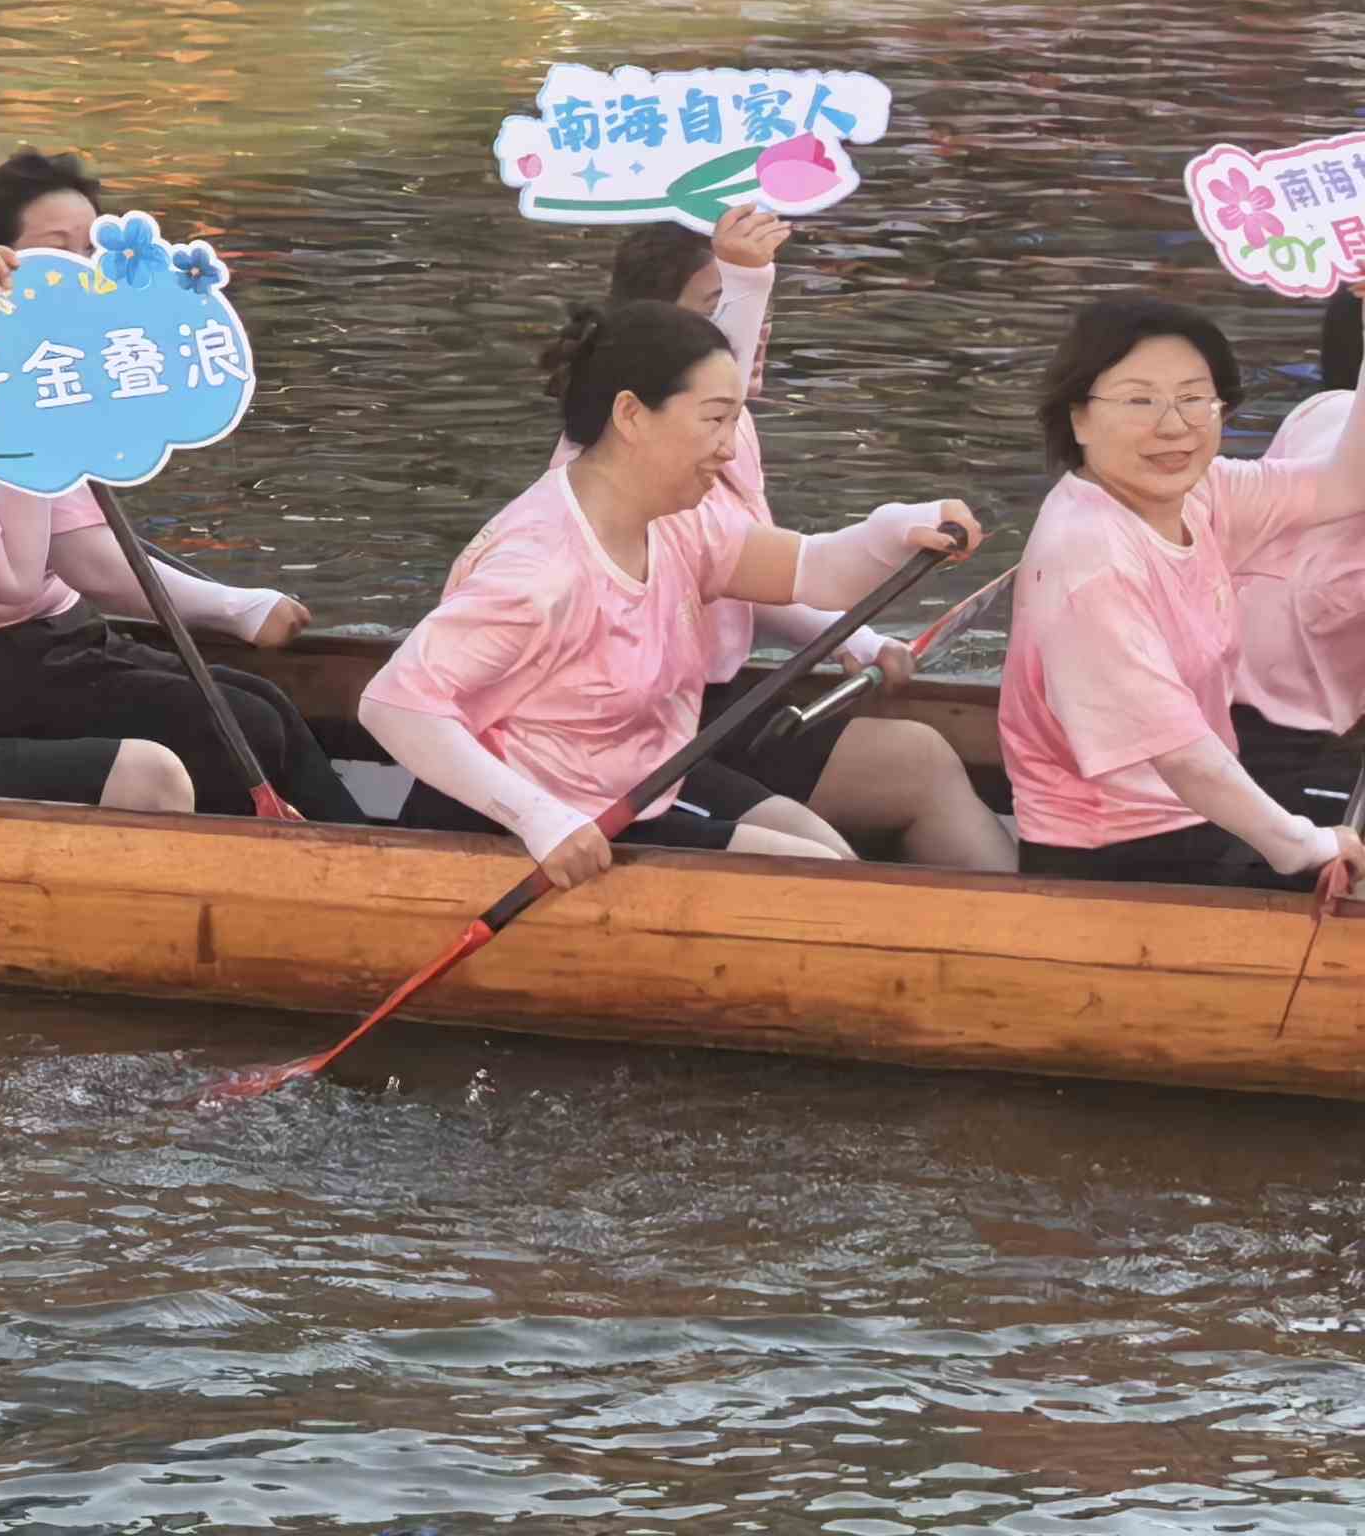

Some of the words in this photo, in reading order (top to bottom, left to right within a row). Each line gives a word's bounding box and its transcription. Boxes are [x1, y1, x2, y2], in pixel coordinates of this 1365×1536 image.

[547, 83, 859, 153] 南海自家人
[1274, 153, 1365, 213] 南海
